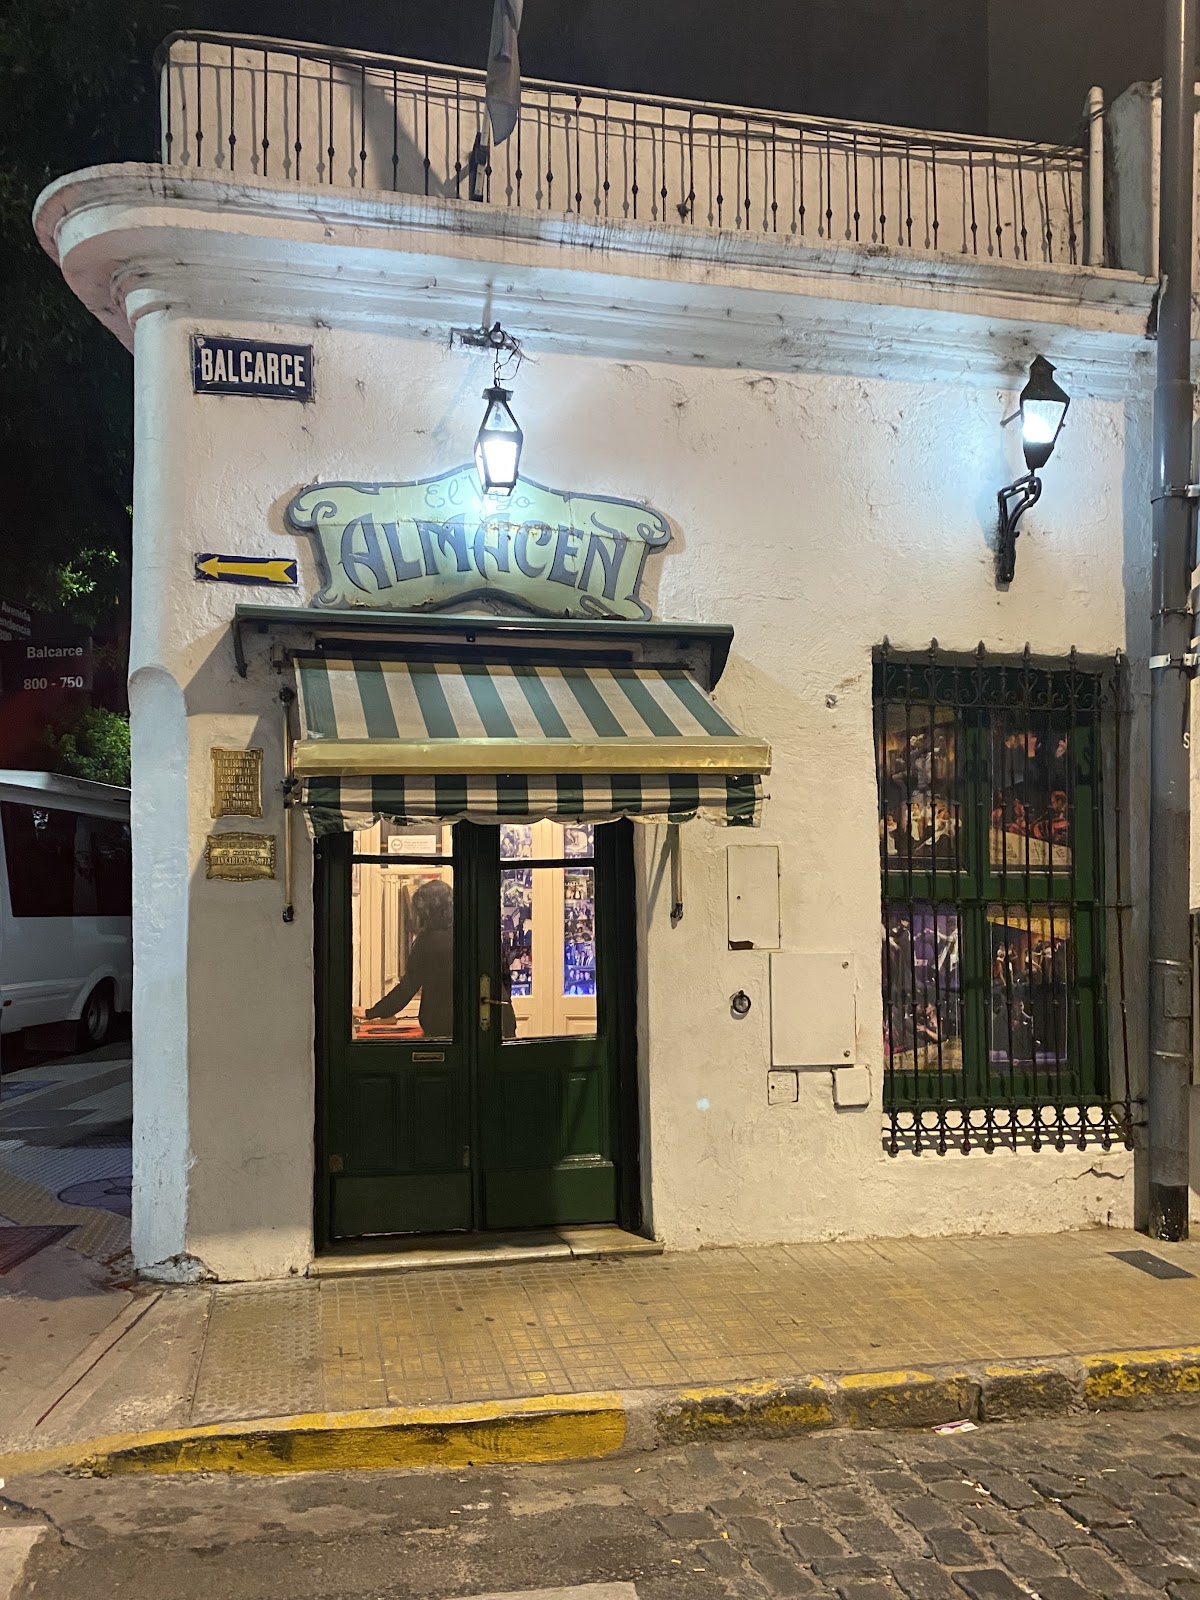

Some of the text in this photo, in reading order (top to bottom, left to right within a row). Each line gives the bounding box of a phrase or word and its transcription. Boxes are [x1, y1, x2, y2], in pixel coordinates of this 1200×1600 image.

[201, 348, 306, 387] BALCARCE
[425, 479, 463, 509] El
[338, 512, 626, 600] ALMACEN
[26, 646, 84, 659] Balcarce
[23, 677, 48, 690] 800
[60, 675, 84, 689] 750
